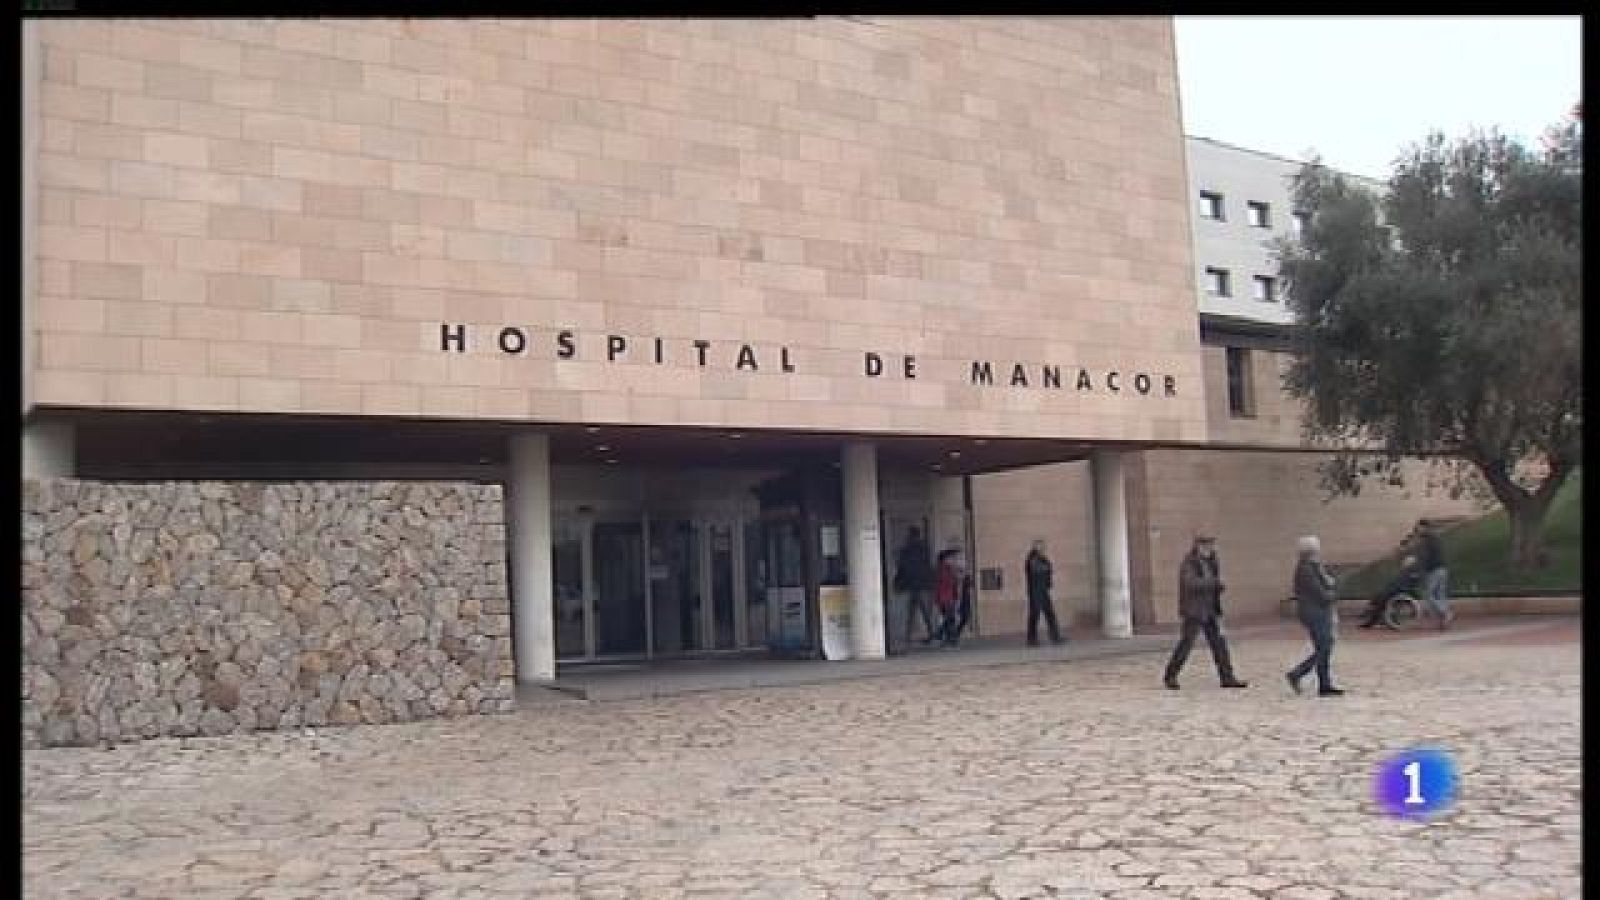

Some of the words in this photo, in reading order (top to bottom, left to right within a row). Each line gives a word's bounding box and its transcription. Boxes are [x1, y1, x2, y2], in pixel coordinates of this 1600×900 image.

[440, 323, 795, 373] HOSPITAL
[865, 351, 918, 380] DE
[971, 360, 1178, 397] MANACOR
